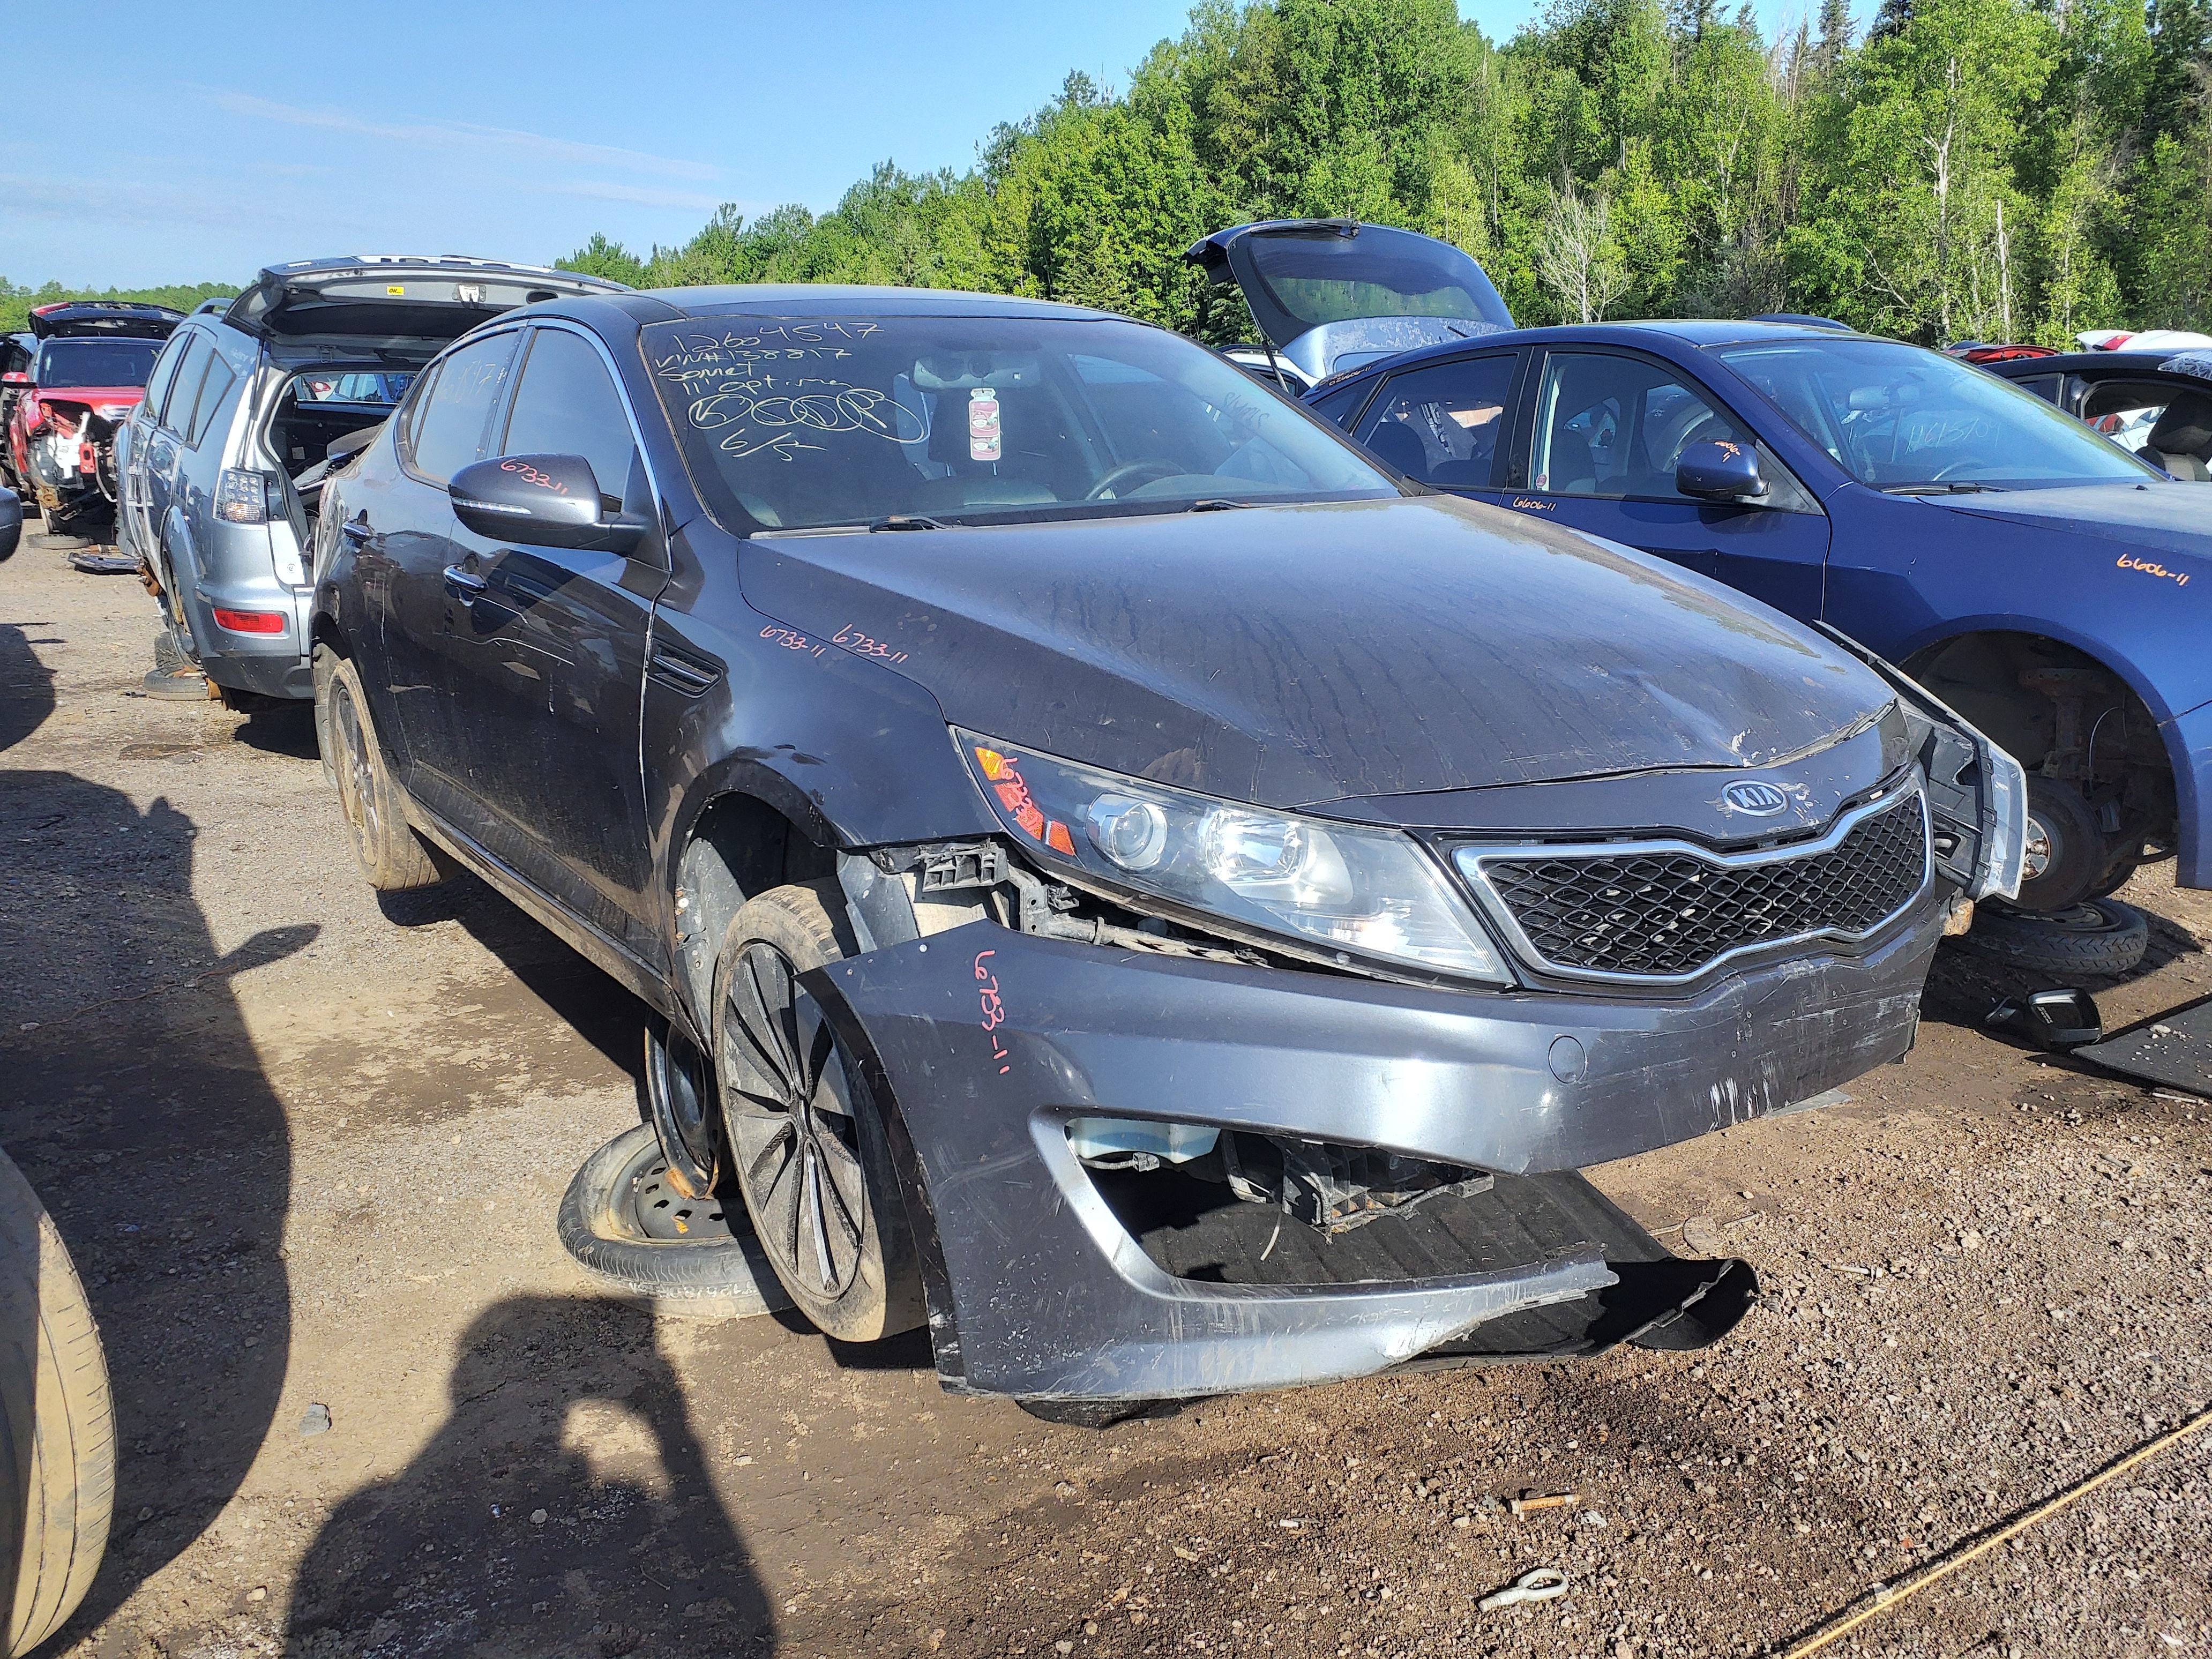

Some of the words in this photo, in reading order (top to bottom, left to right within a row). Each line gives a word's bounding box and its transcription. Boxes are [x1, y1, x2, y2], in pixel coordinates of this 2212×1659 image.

[500, 459, 569, 495] 6733-11
[1512, 496, 1557, 512] 6606-11
[2116, 553, 2190, 586] 6606-11
[759, 624, 827, 659] 6733-11
[832, 623, 909, 664] 6733-11
[1730, 786, 1782, 808] KIA
